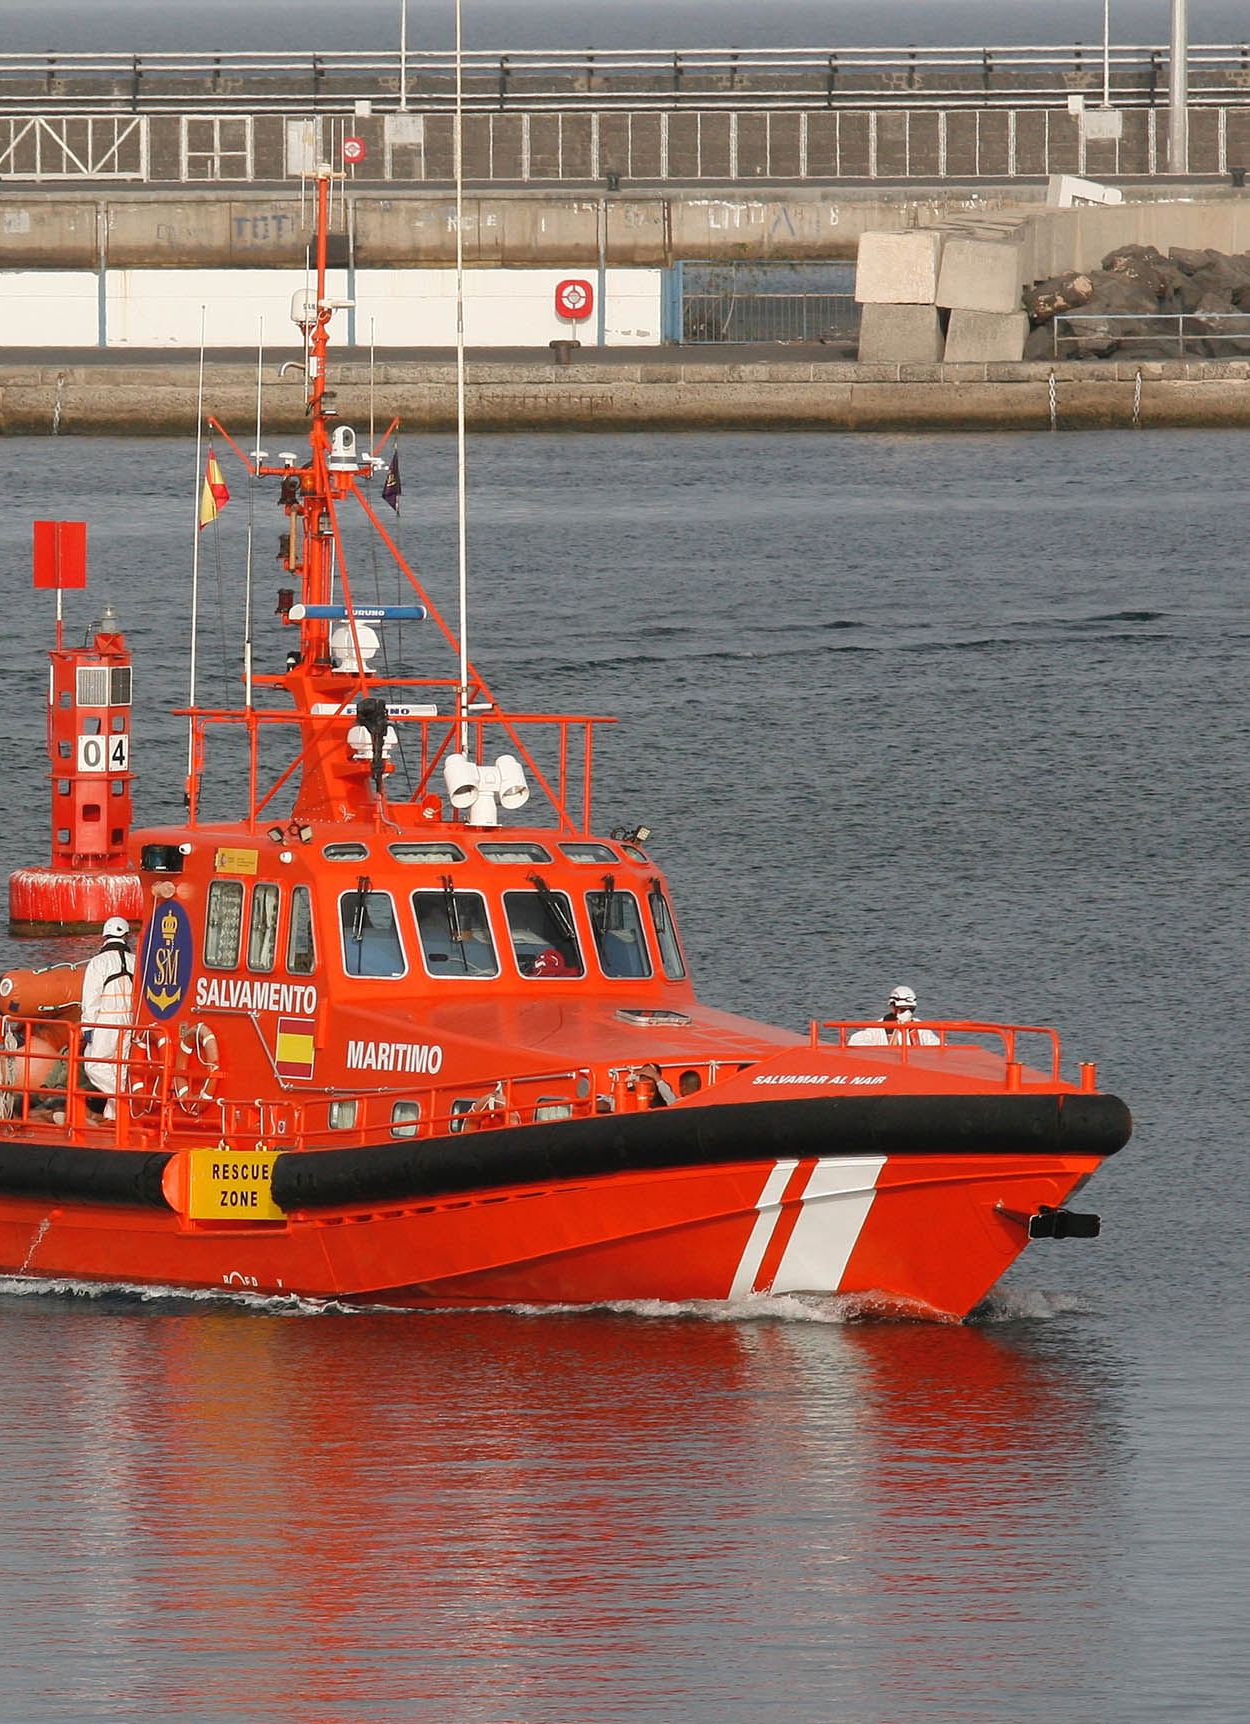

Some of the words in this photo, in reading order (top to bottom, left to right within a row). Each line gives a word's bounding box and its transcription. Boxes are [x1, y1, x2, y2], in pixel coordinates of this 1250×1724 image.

[195, 977, 317, 1015] SALVAMENTO
[346, 1040, 444, 1075] MARITIMO
[752, 1075, 829, 1085] SALVAMAR
[828, 1075, 848, 1085] AL
[850, 1075, 887, 1085] NAIR
[212, 1164, 269, 1180] RESCUE
[220, 1190, 258, 1207] ZONE
